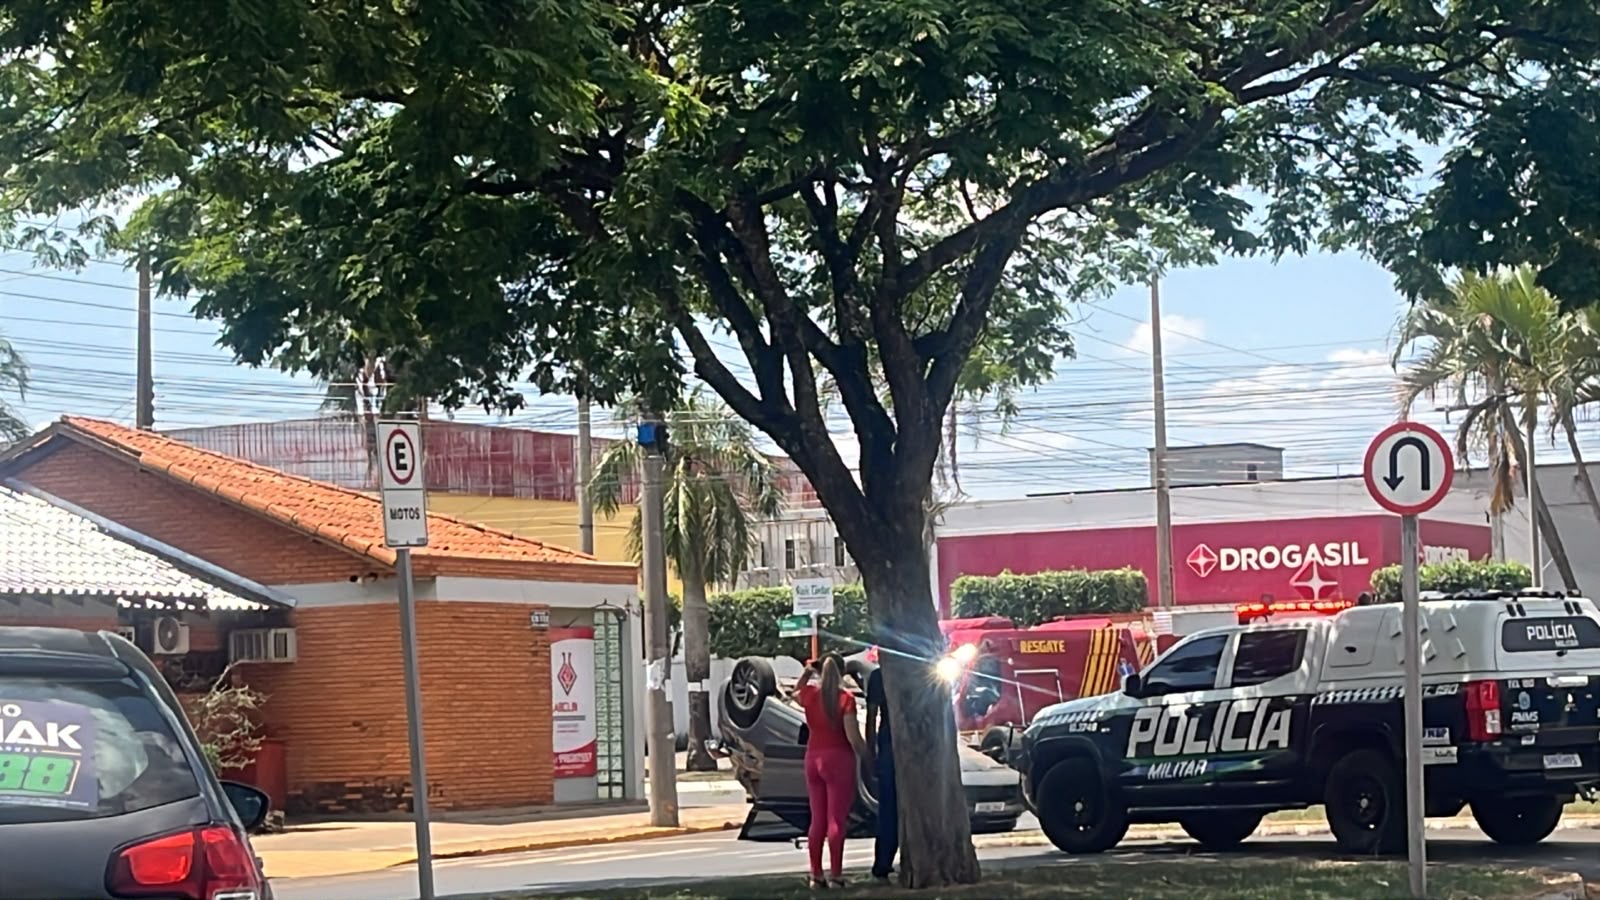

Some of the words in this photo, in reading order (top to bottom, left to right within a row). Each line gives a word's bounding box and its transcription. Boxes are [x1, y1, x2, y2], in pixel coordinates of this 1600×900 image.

[394, 442, 408, 471] E
[390, 507, 420, 520] MOTOS
[1219, 542, 1369, 571] DROGASIL
[1020, 640, 1066, 653] RESGATE
[0, 718, 82, 750] AK
[1147, 759, 1208, 779] MILITAR
